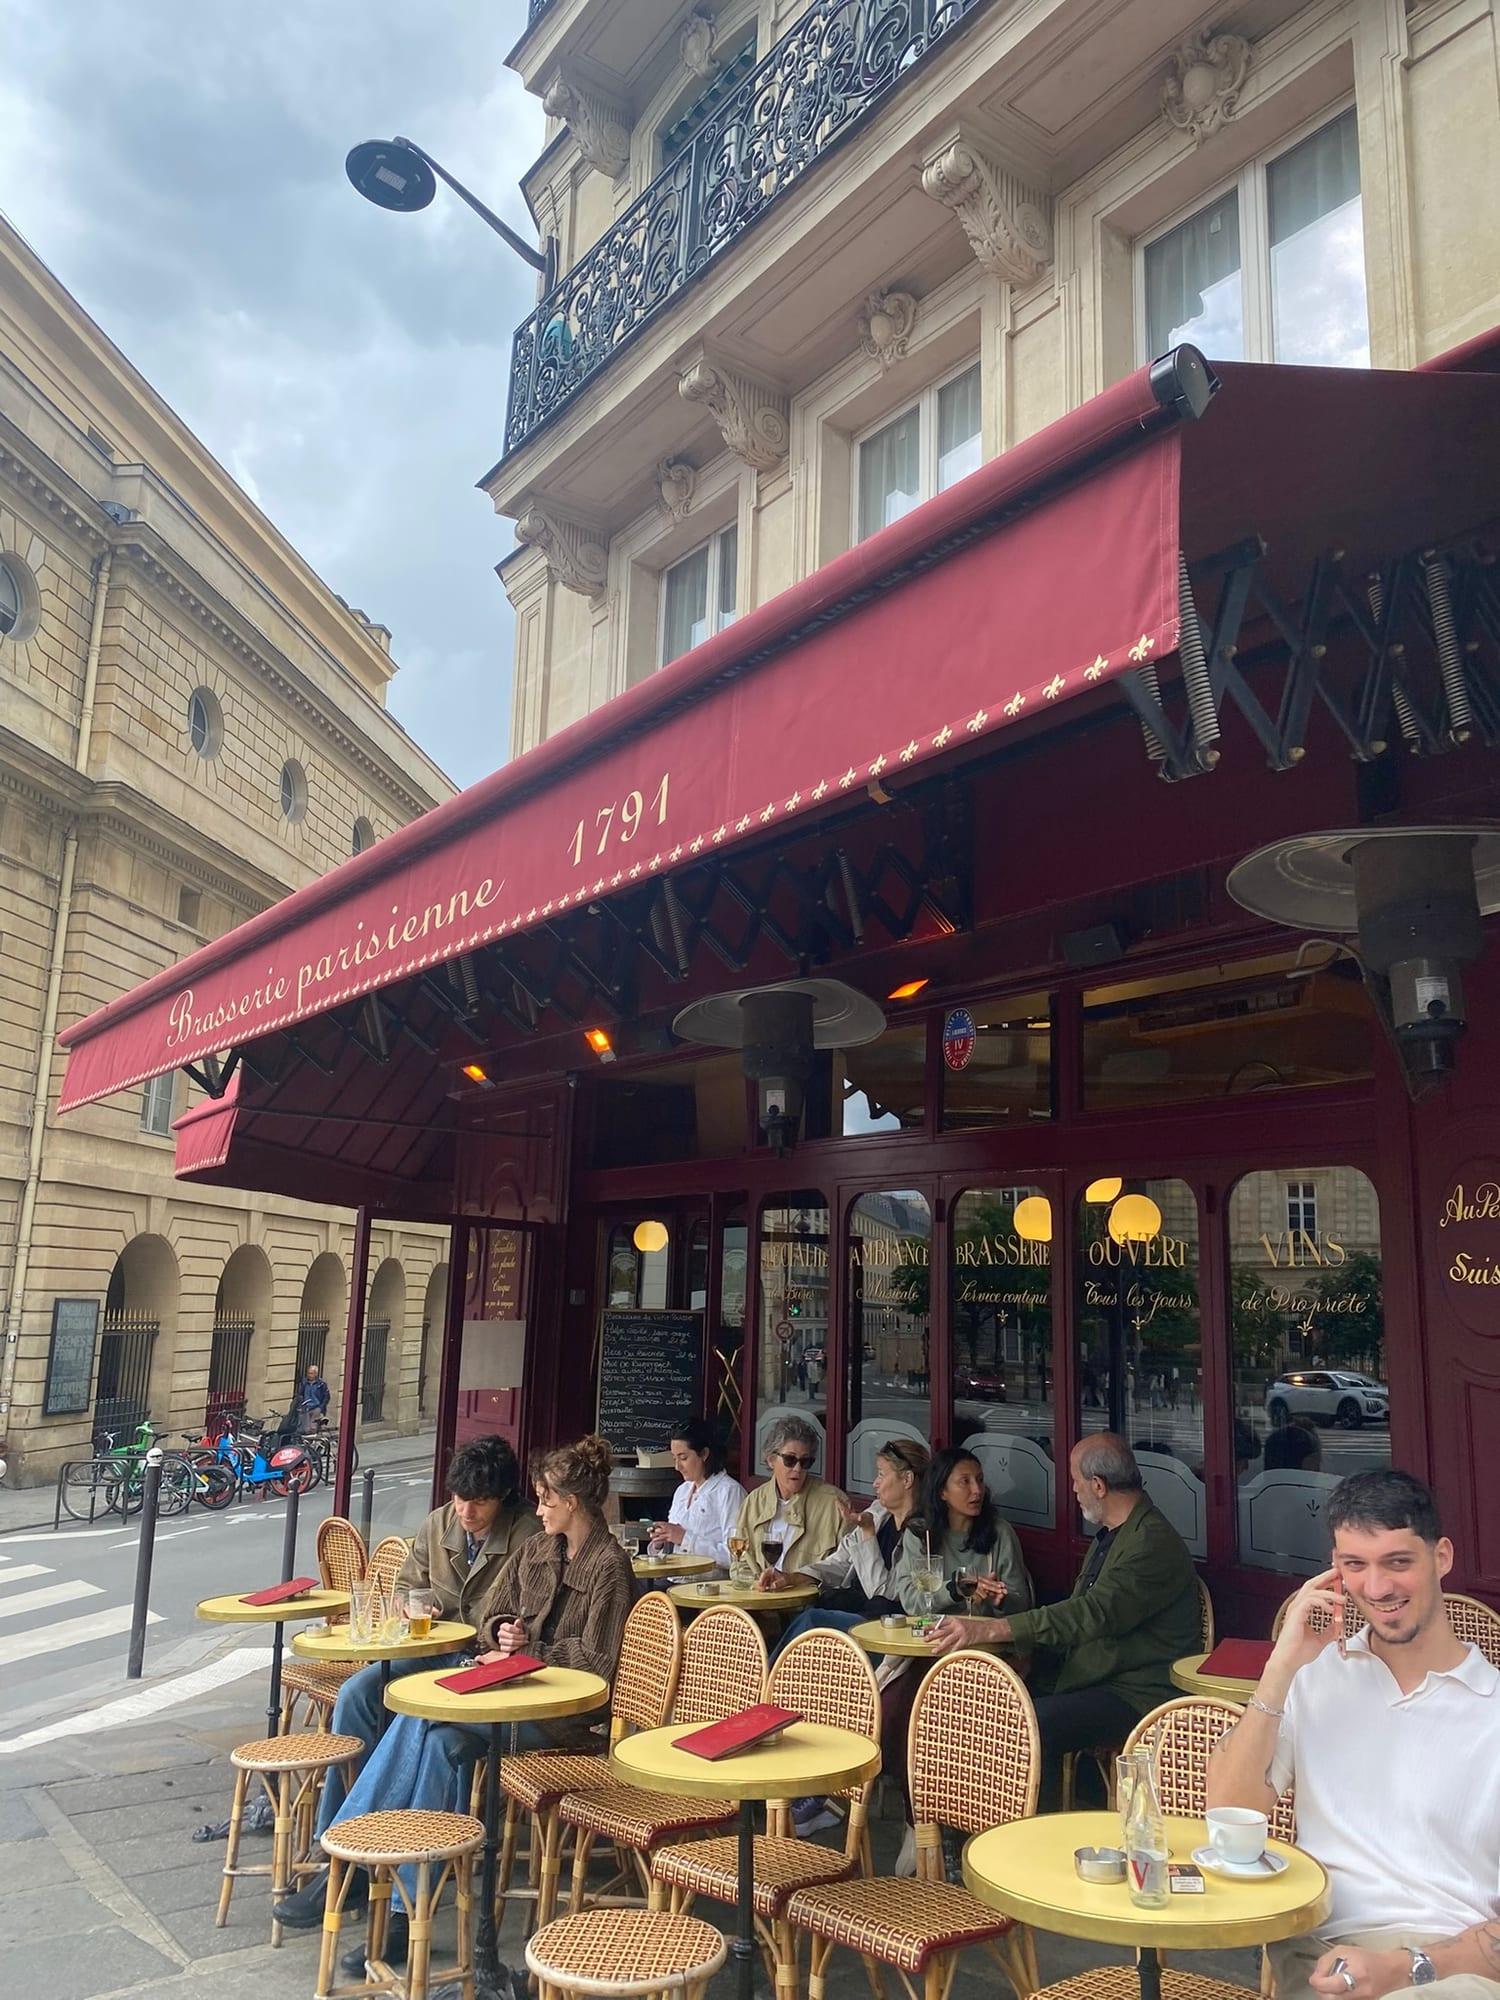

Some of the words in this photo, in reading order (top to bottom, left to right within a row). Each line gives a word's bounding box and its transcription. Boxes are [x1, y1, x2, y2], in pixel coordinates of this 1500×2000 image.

[567, 772, 670, 866] 1791
[166, 968, 291, 1047] Brasserie
[297, 878, 505, 1009] parisienne
[1440, 1184, 1475, 1227] Au
[850, 1239, 929, 1266] AMBIANCE
[955, 1234, 1051, 1267] BRASSERIE
[1089, 1232, 1189, 1268] OUVERT
[1260, 1231, 1345, 1268] VINS
[955, 1275, 1000, 1303] Service
[1002, 1286, 1048, 1305] continu
[1084, 1280, 1118, 1305] Tous
[1126, 1282, 1145, 1306] les
[1241, 1290, 1261, 1310] de
[1266, 1285, 1370, 1326] Propriété
[1131, 1860, 1149, 1890] V
